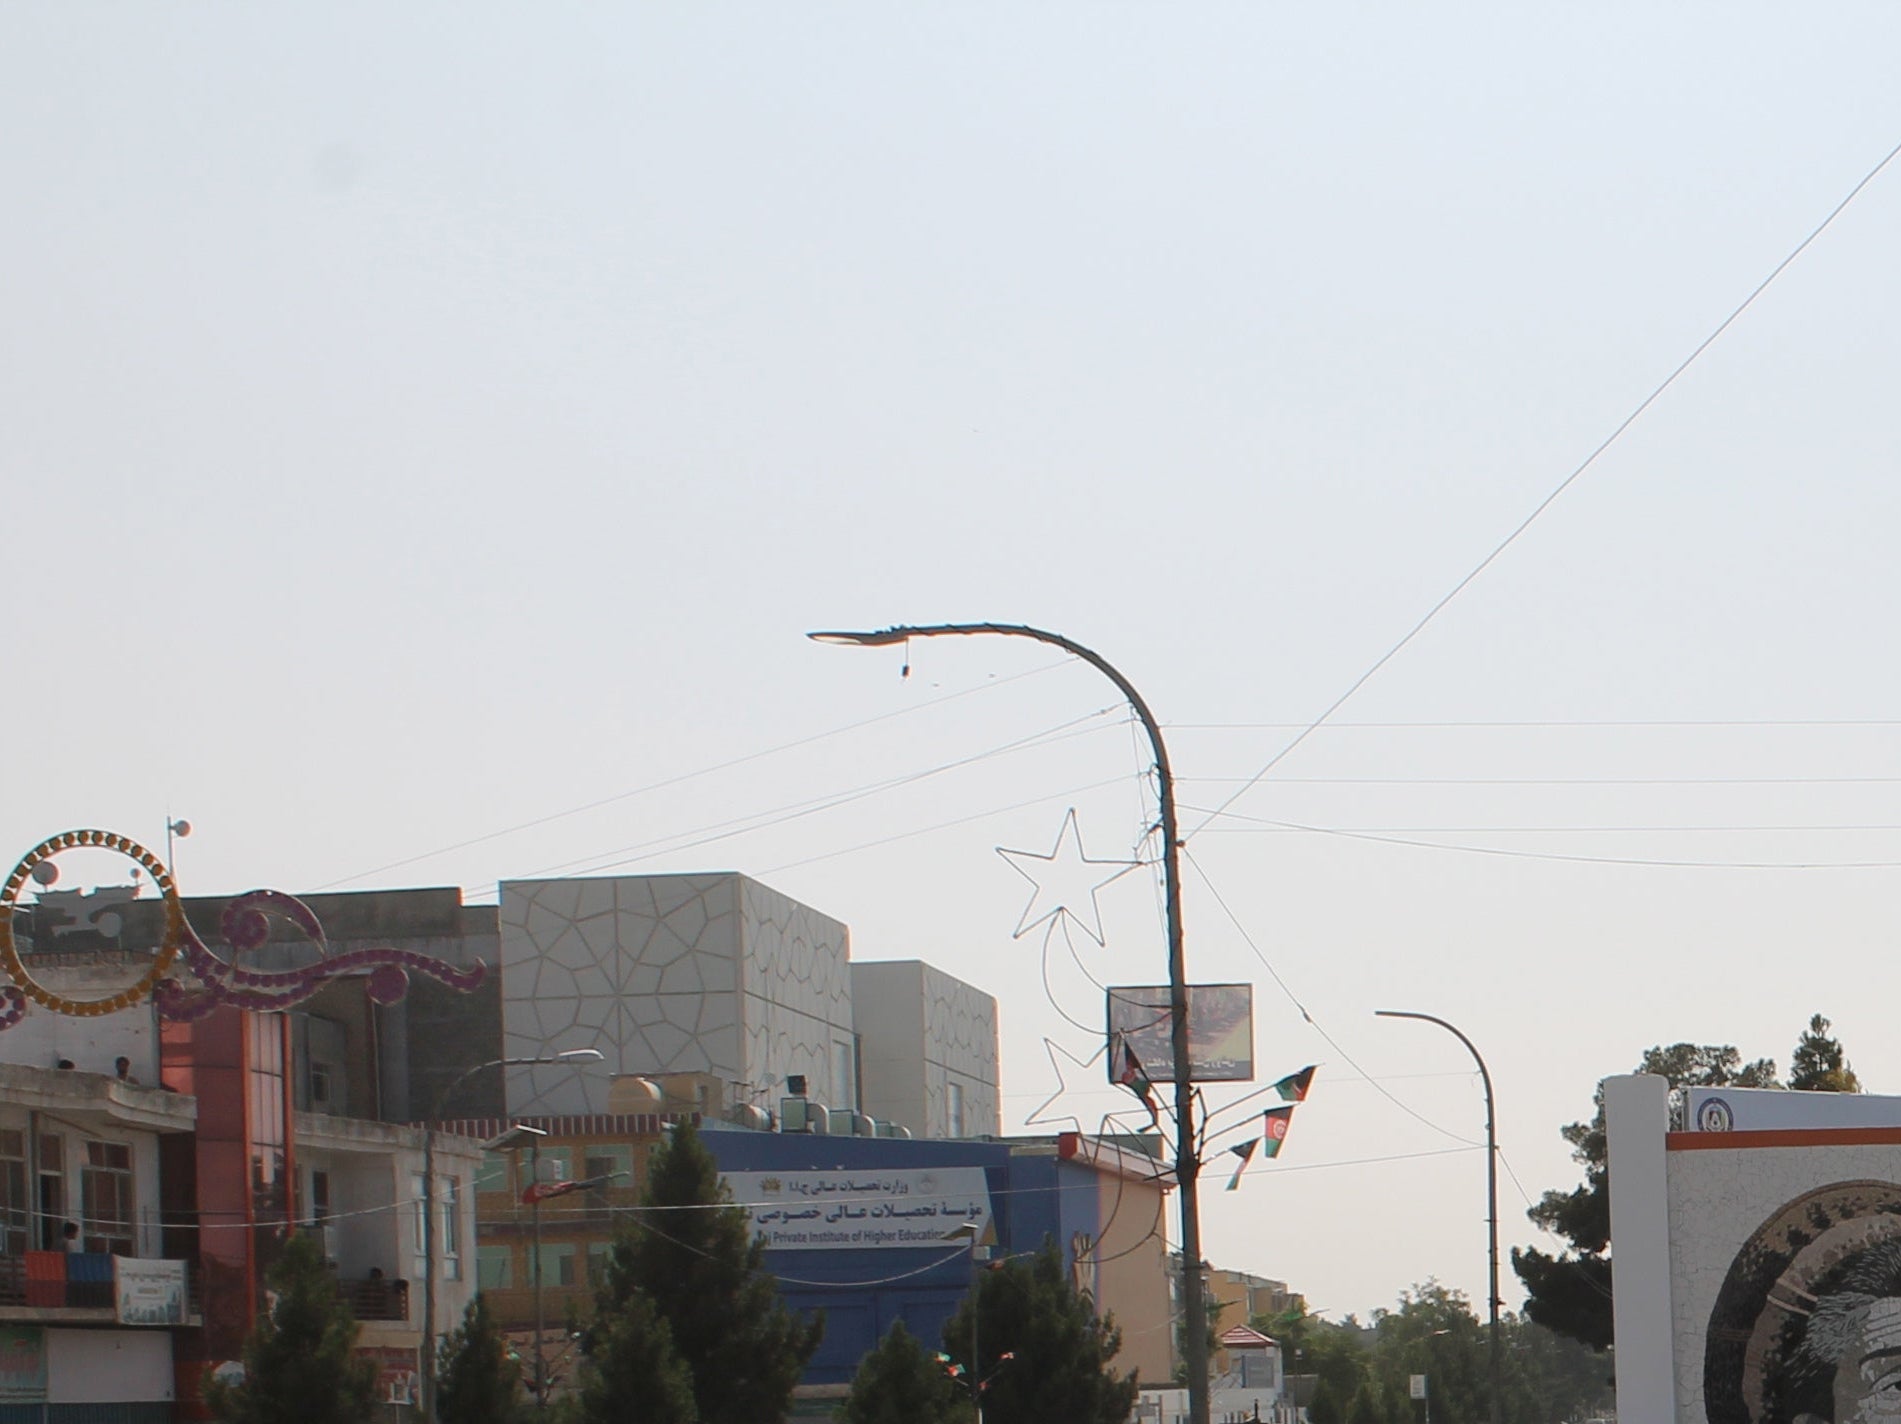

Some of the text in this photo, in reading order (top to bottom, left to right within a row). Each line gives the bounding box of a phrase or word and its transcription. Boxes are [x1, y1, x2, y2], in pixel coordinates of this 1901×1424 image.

[811, 1180, 837, 1195] عالی
[840, 1179, 881, 1193] تحصیلات
[883, 1179, 908, 1194] وزارت
[757, 1205, 822, 1224] خصوصی
[825, 1204, 867, 1224] عالی
[871, 1203, 937, 1221] تحصیلات
[772, 1231, 807, 1243] Private
[809, 1230, 850, 1243] Institute
[852, 1230, 862, 1242] of
[864, 1230, 896, 1244] Higher
